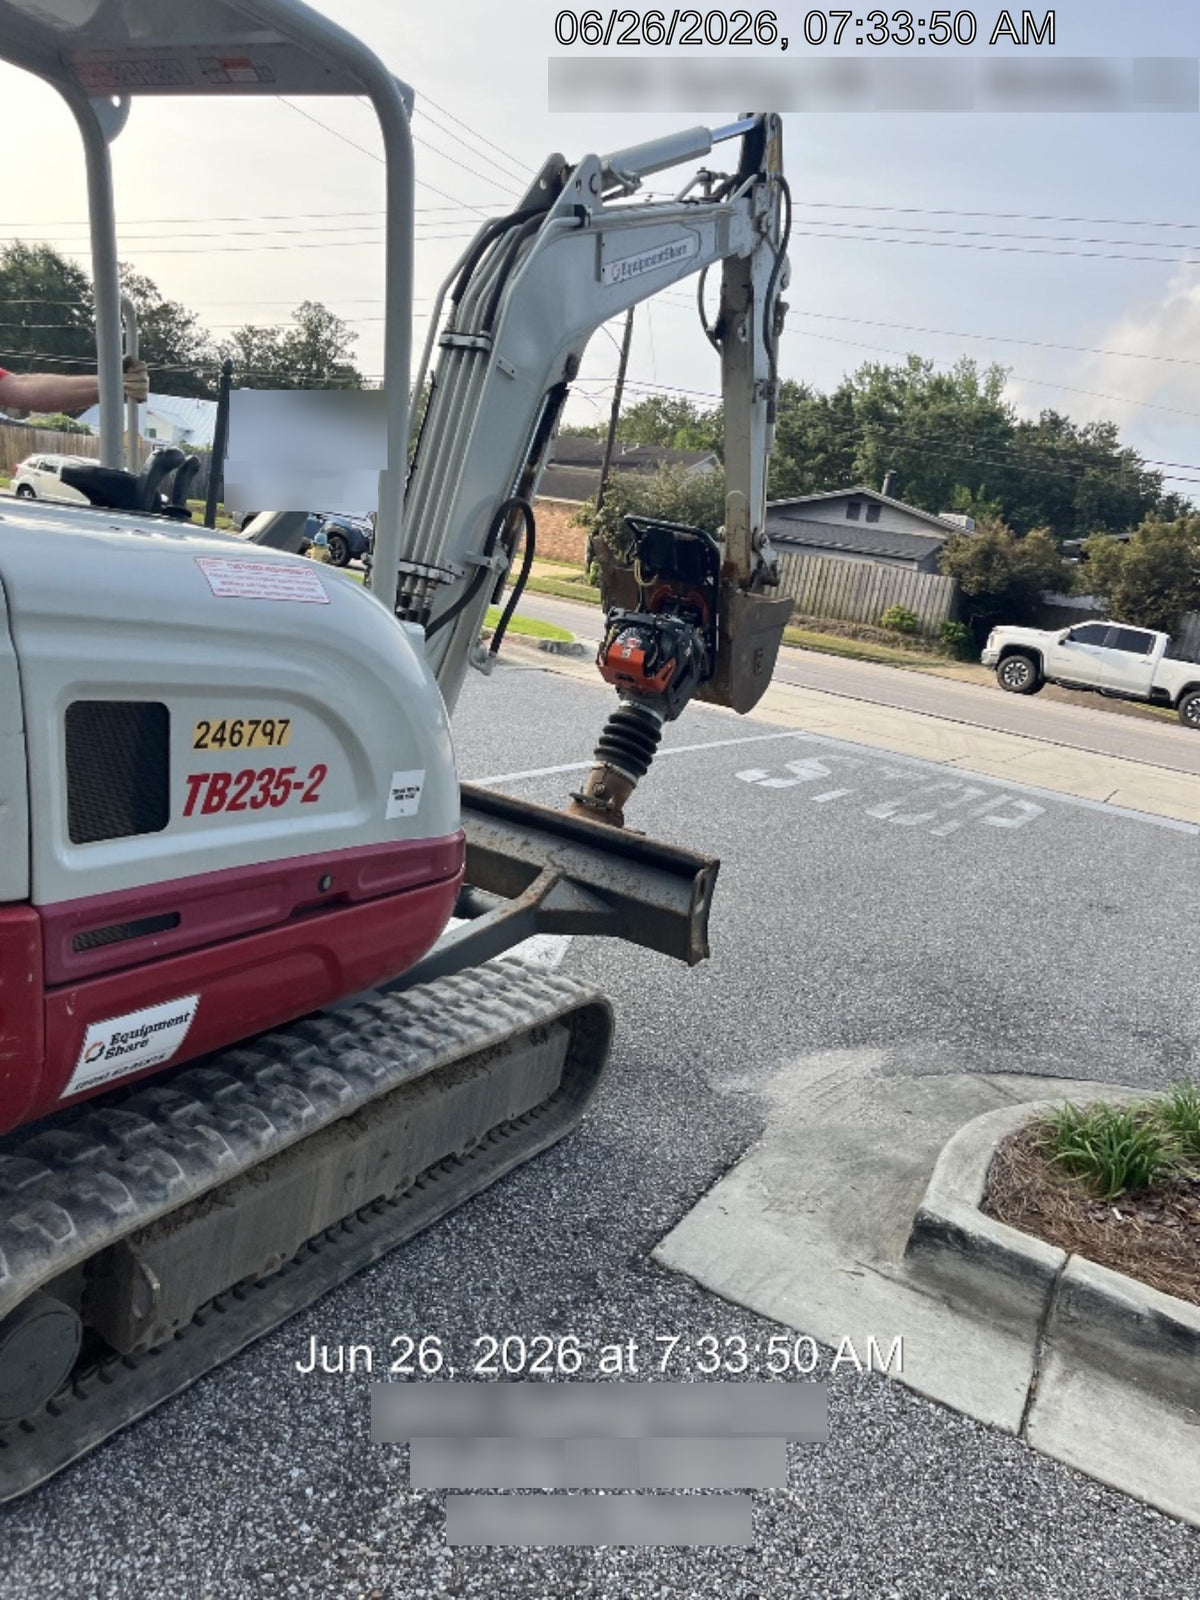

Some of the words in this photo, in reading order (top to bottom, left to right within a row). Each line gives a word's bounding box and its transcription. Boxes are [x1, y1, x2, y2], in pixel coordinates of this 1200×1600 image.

[193, 719, 290, 750] 246797
[183, 763, 328, 817] TB235-2
[735, 754, 1046, 837] STOP
[109, 1011, 191, 1046] Equipment
[104, 1038, 151, 1060] Share
